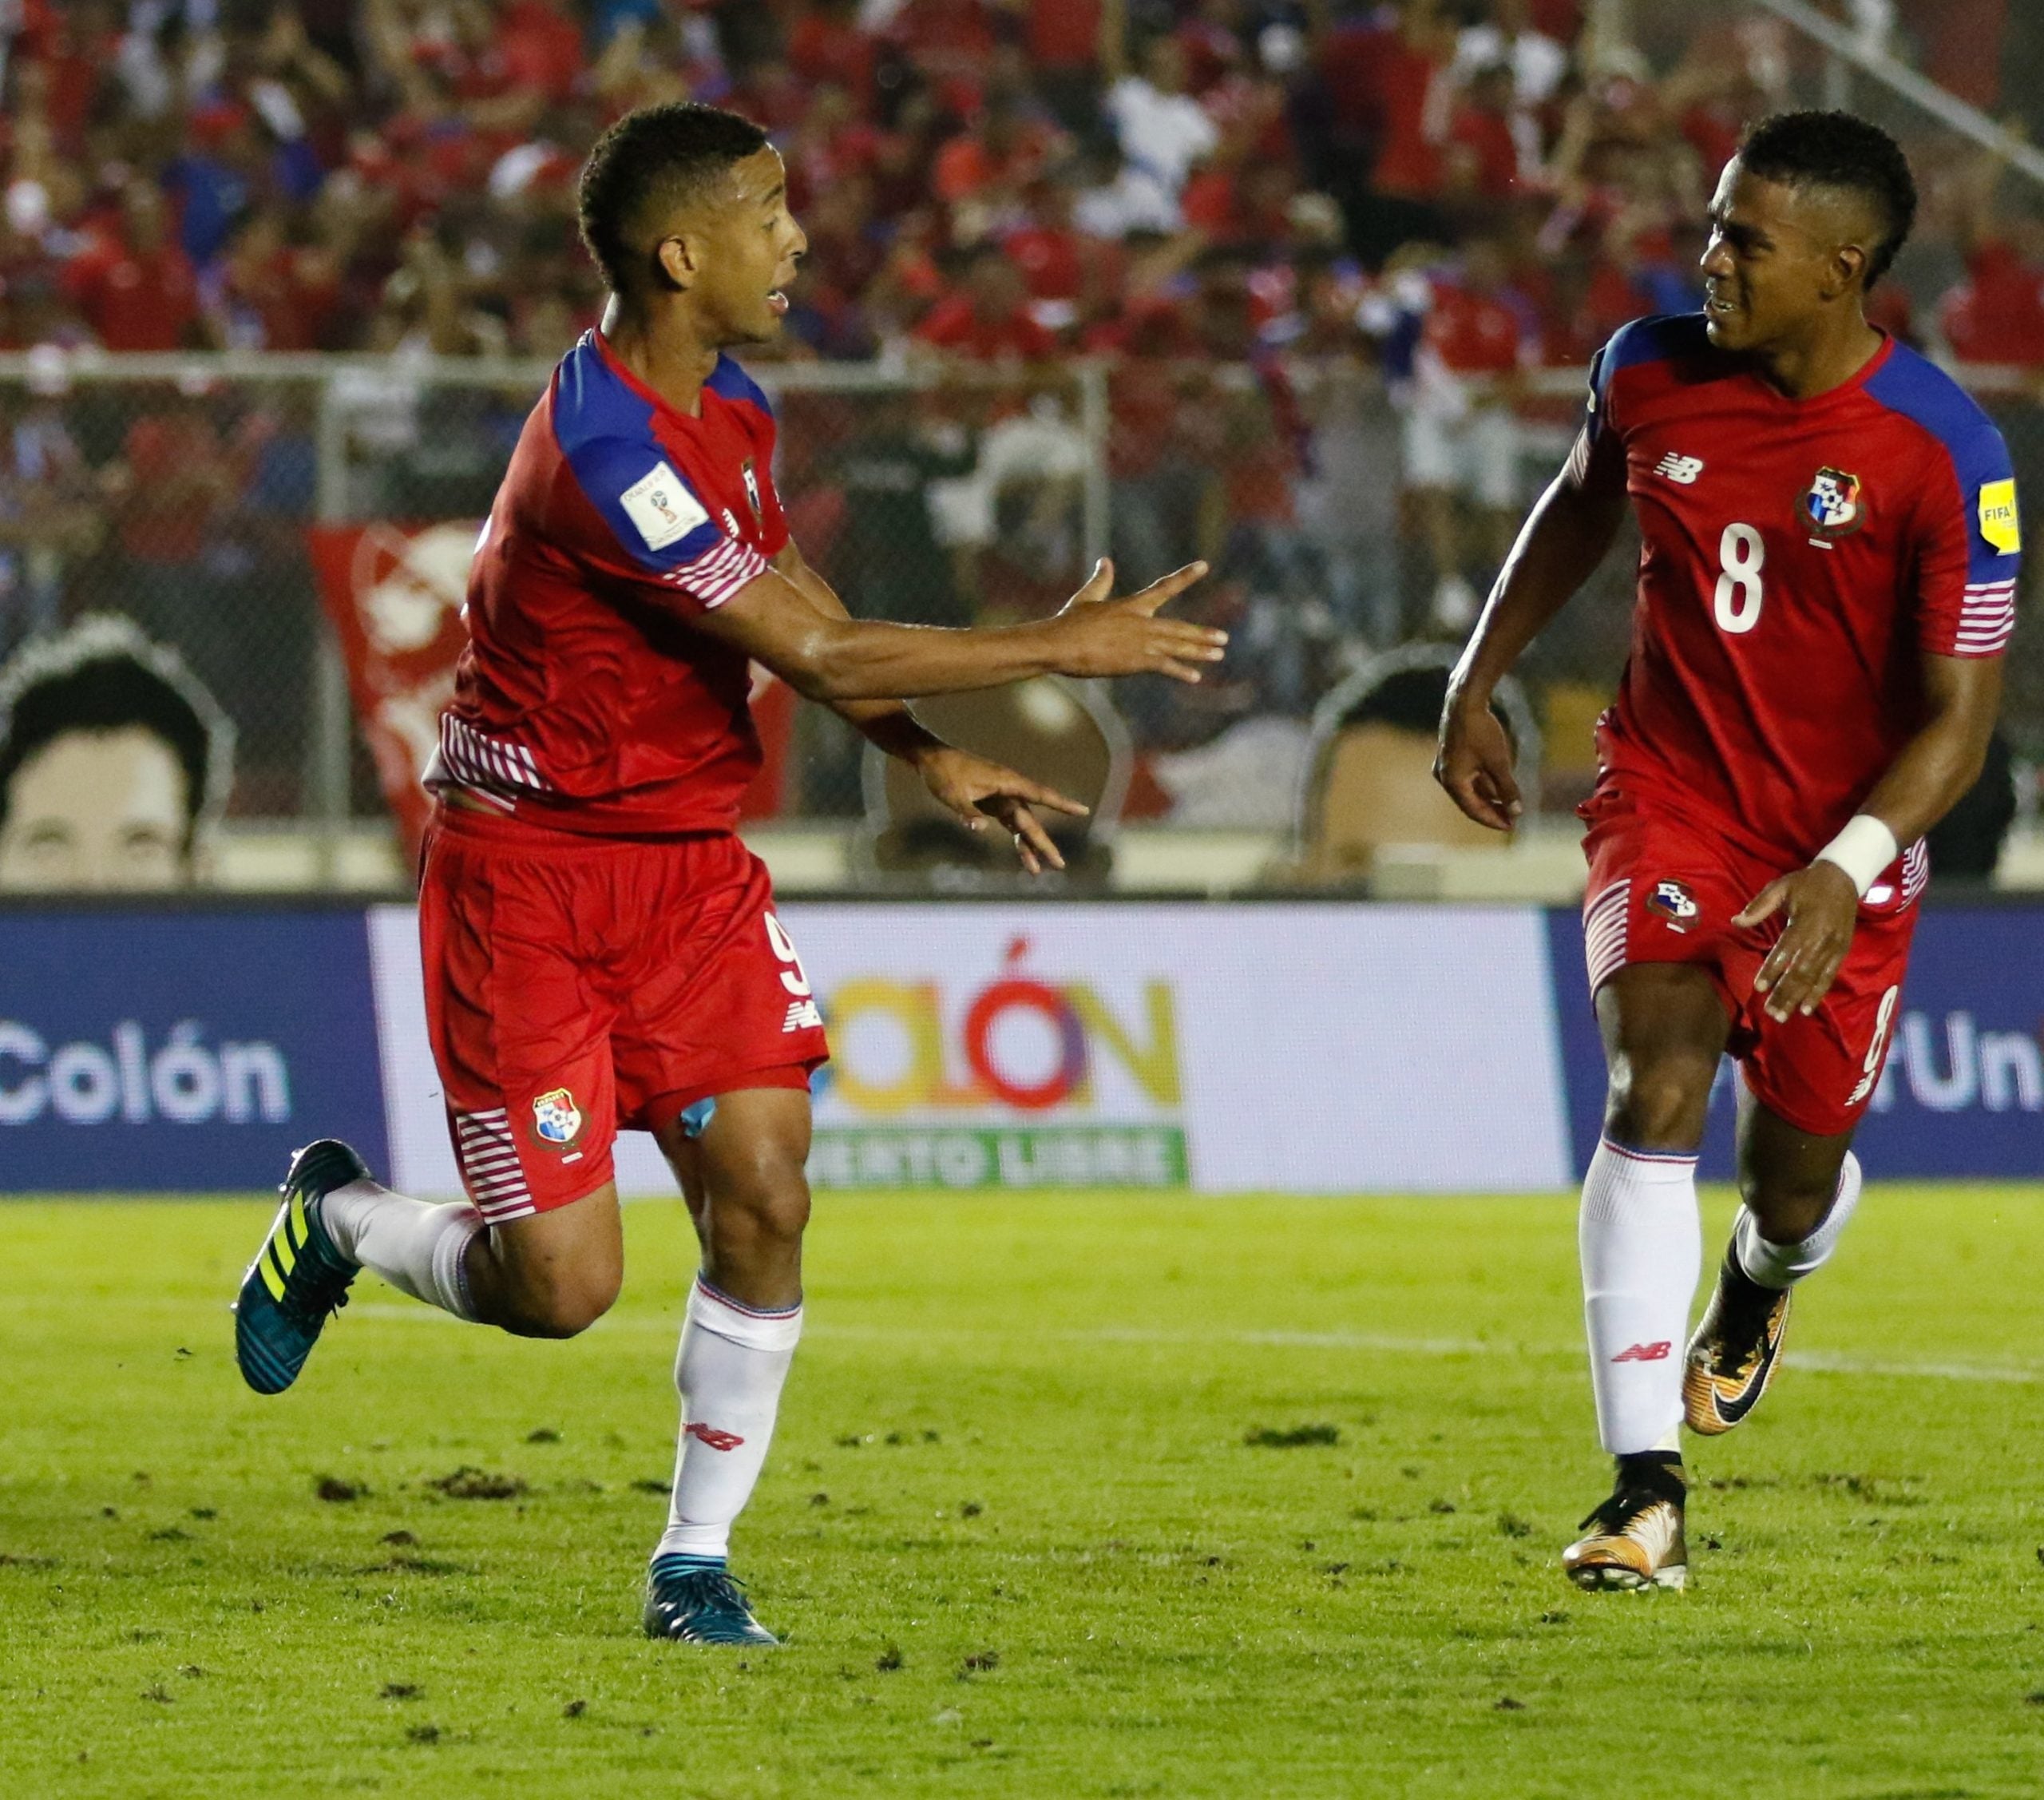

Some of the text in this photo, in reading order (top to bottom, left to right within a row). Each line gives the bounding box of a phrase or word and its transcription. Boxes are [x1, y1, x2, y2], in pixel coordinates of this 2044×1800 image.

[1984, 506, 2010, 521] FIFA
[1714, 522, 1765, 633] 8
[763, 910, 811, 997] 9
[0, 1018, 292, 1125] Colón
[808, 933, 1182, 1111] OLÓN
